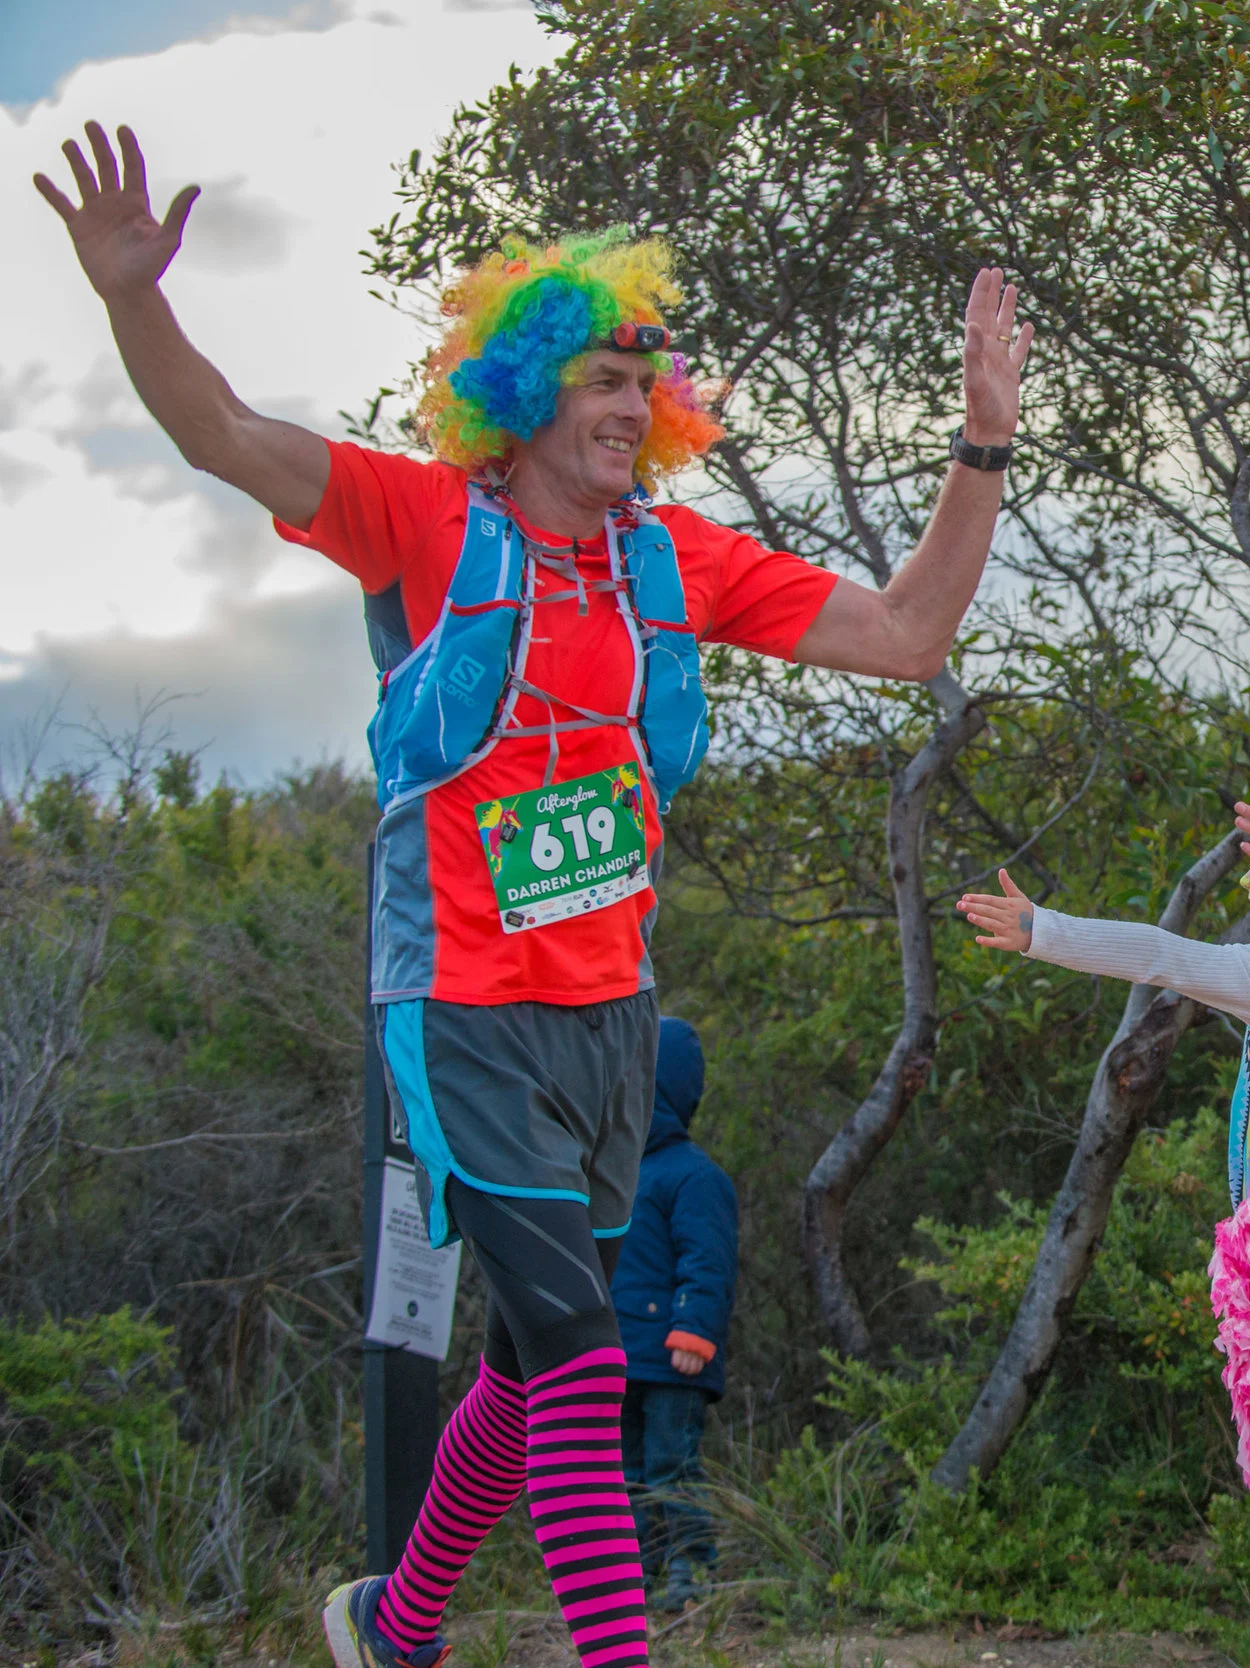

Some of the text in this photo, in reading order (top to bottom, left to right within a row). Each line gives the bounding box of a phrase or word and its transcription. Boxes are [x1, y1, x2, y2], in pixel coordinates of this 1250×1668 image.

[536, 785, 598, 814] Afterglow
[530, 806, 616, 872] 619
[507, 849, 641, 902] DARREN CHANDLER
